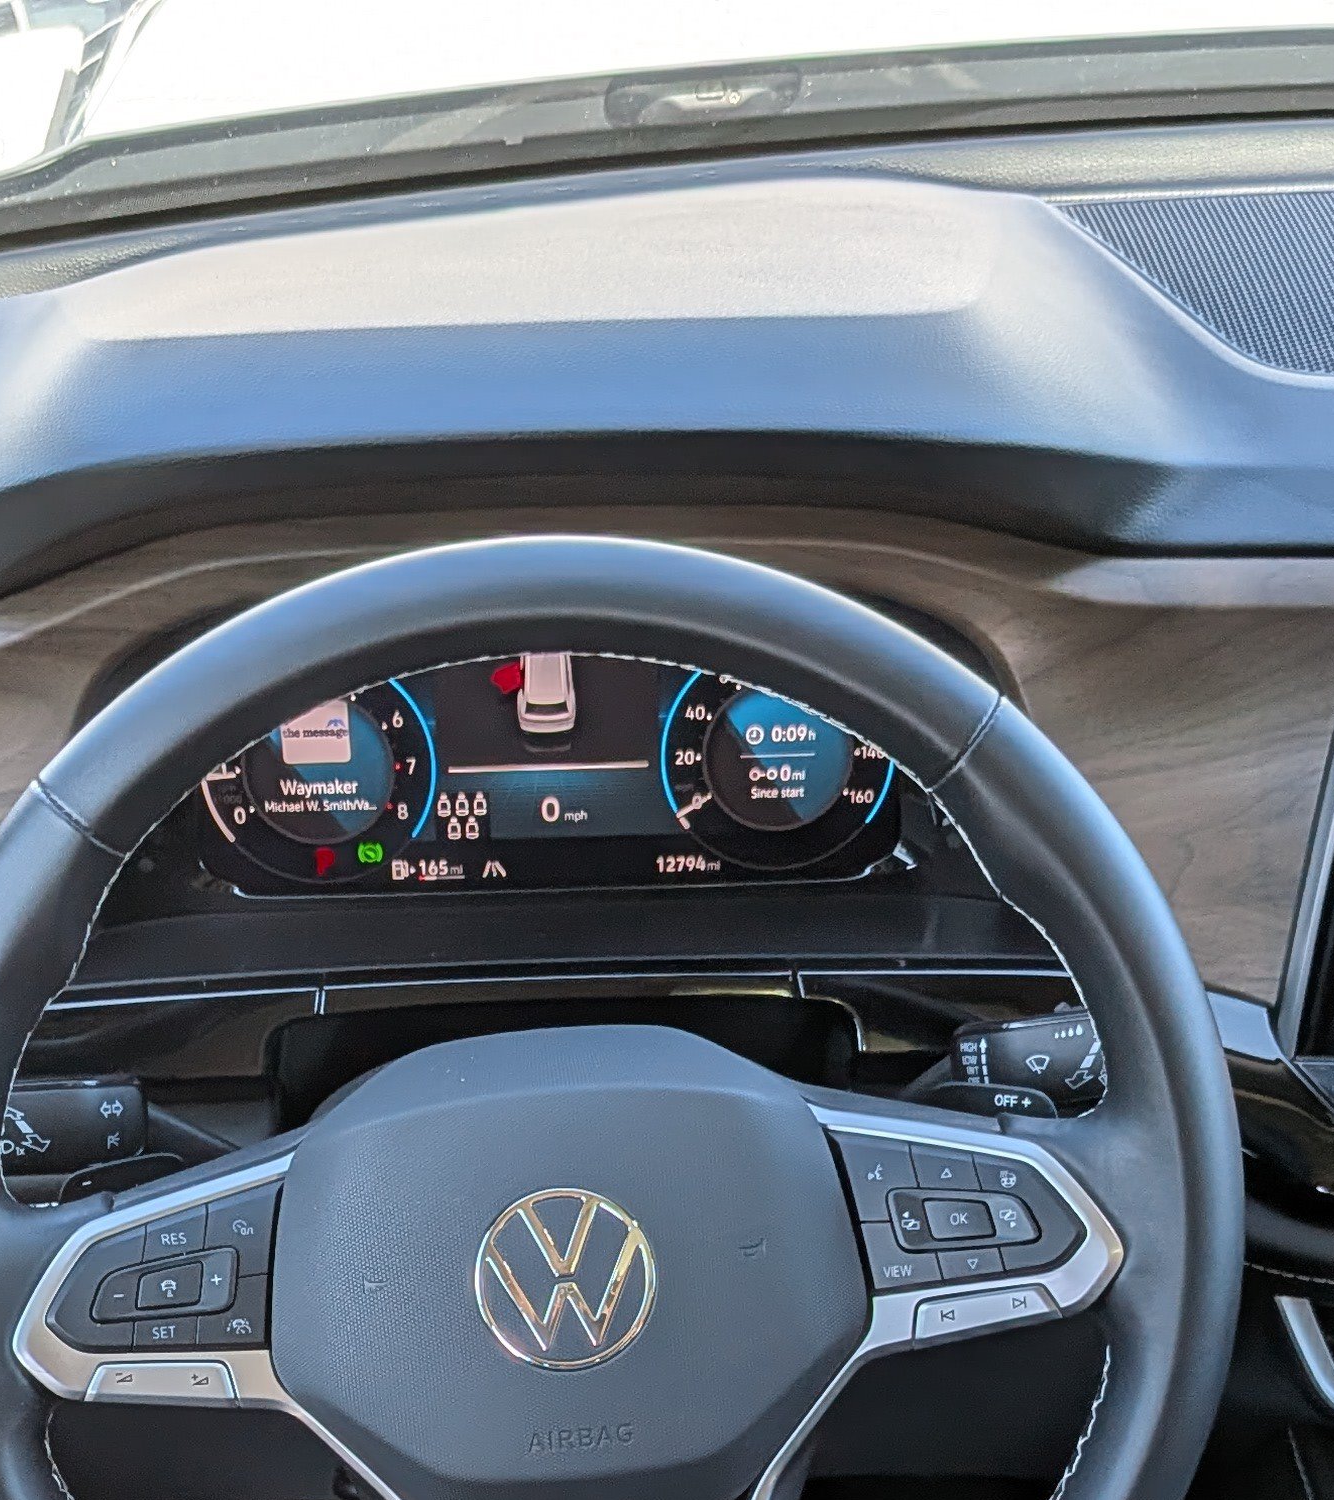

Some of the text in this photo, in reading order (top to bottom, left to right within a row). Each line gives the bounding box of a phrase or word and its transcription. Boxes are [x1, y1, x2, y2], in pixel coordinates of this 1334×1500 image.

[392, 710, 404, 728] 6
[685, 704, 705, 721] 40
[302, 727, 349, 740] message
[771, 724, 807, 742] 0:09
[675, 748, 695, 765] 20
[405, 757, 416, 775] 7
[279, 777, 358, 798] Waymaker
[751, 784, 805, 799] Since start
[849, 787, 874, 804] 160
[234, 805, 246, 825] 0
[264, 800, 305, 813] Michael
[306, 800, 321, 812] W.
[397, 802, 409, 820] 8
[541, 795, 588, 824] 0 mph
[419, 859, 463, 876] 165 mi
[656, 854, 720, 873] 12794 mi
[994, 1093, 1019, 1108] OFF
[950, 1213, 967, 1225] OK
[160, 1232, 187, 1246] RES
[883, 1264, 913, 1278] VIEW
[152, 1326, 176, 1340] SET
[527, 1422, 635, 1454] AIRBAG
